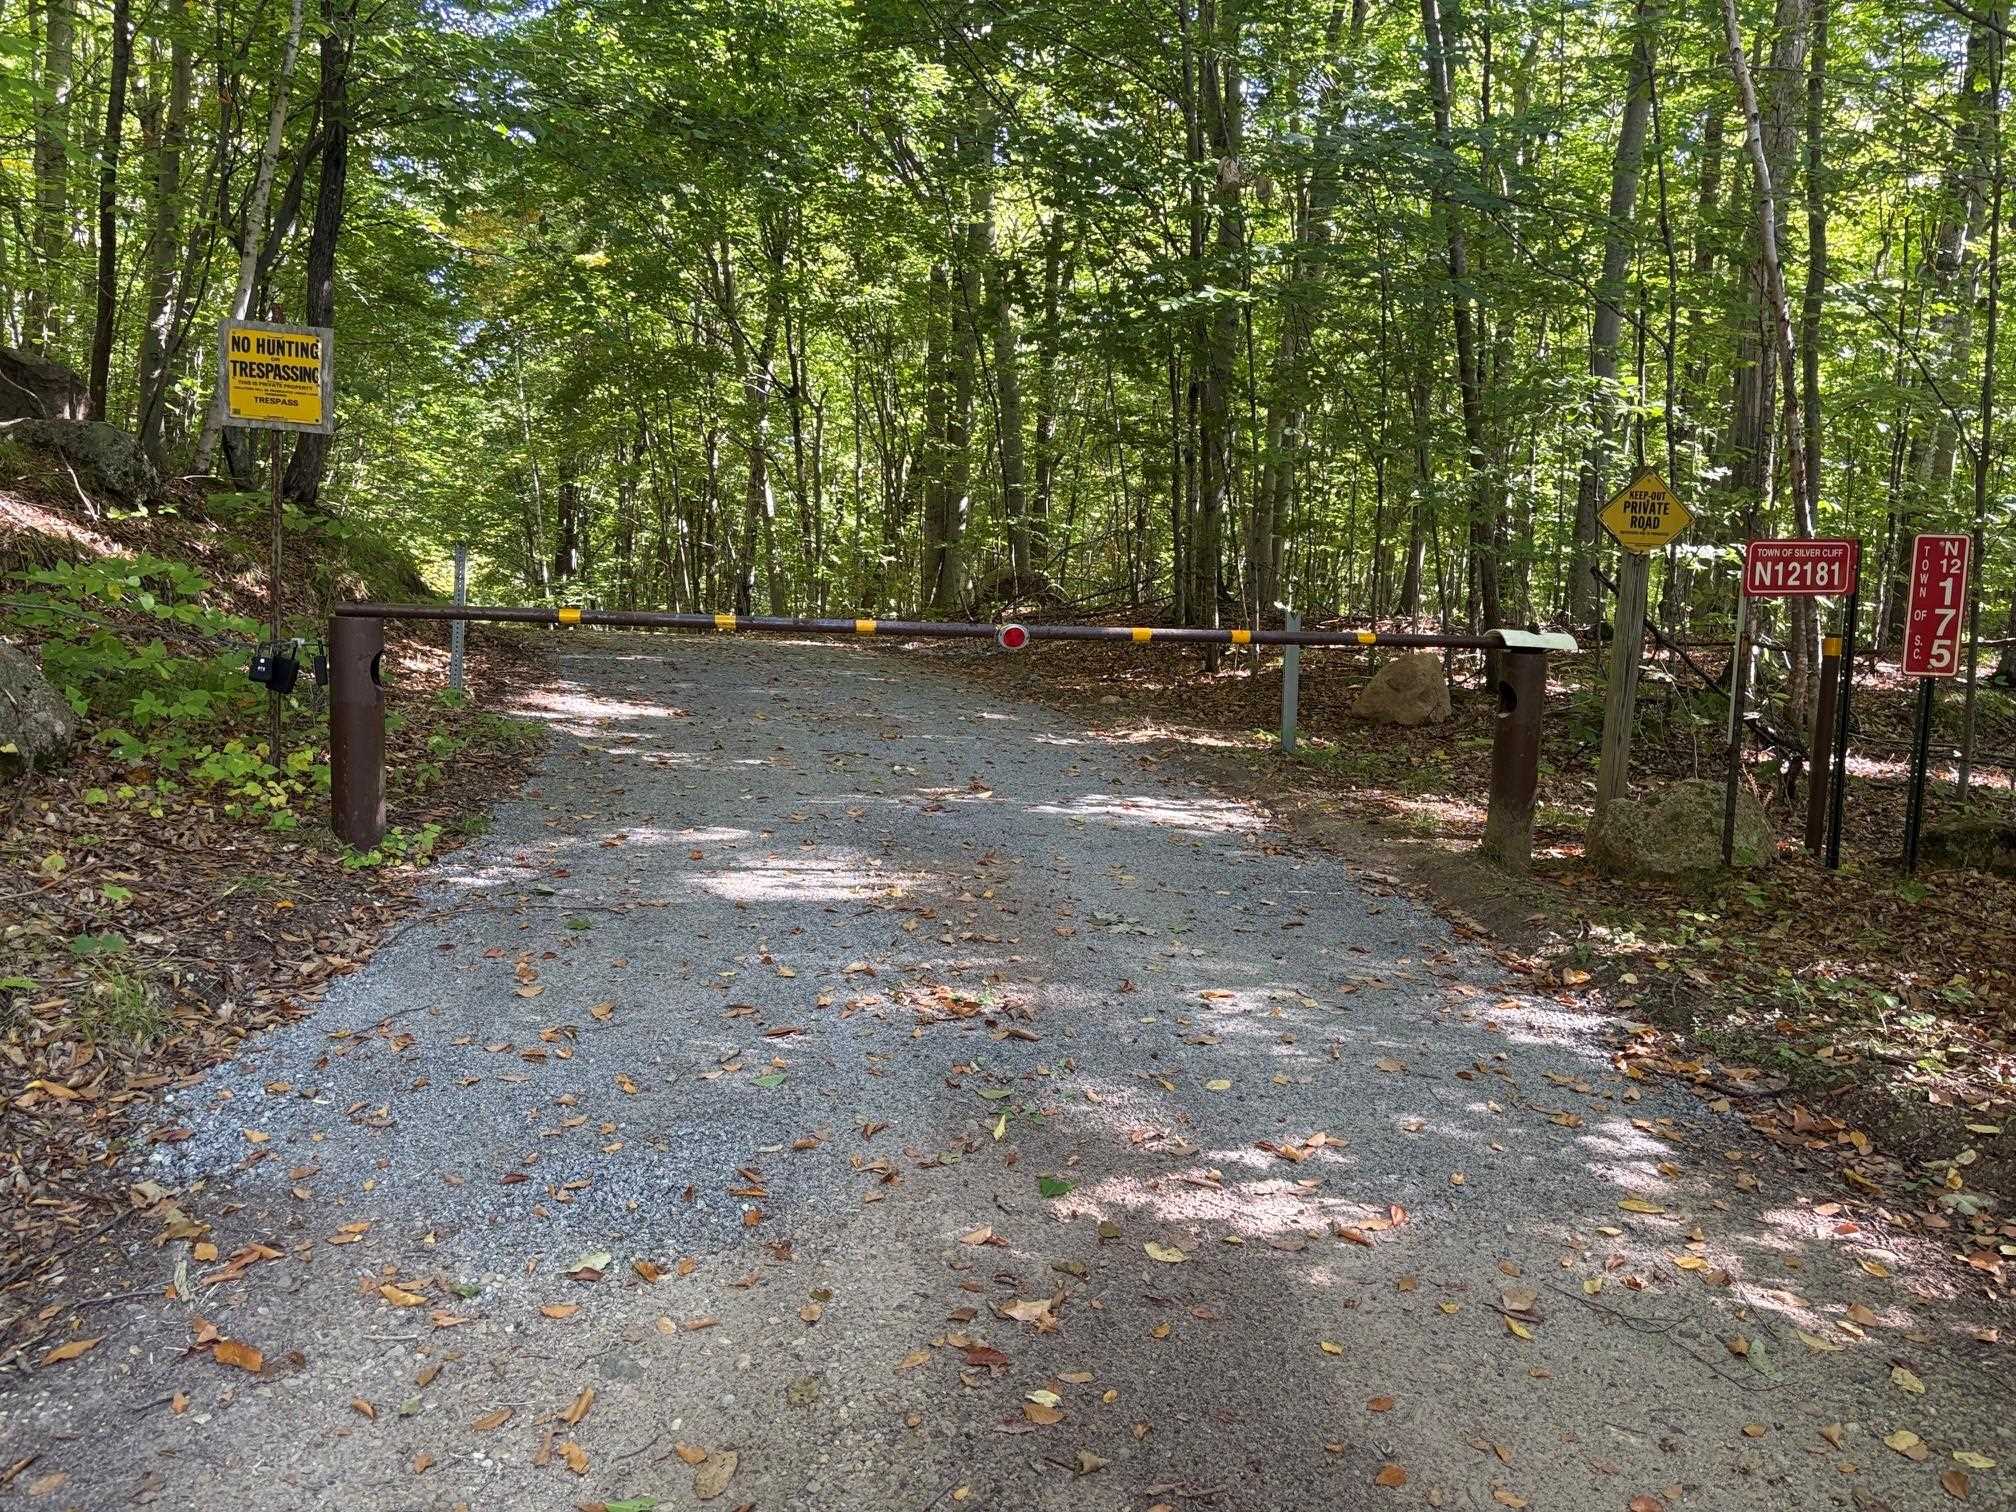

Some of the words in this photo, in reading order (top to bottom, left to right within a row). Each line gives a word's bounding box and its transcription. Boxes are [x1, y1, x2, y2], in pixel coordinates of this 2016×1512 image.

[231, 335, 251, 353] NO
[256, 337, 319, 360] HUNTING
[230, 360, 319, 384] TRESPASSING
[259, 381, 283, 389] PRIVATE
[255, 396, 299, 407] TRESPASS
[1629, 490, 1667, 501] KEEP-OUT
[1623, 501, 1671, 515] PRIVATE
[1630, 515, 1660, 529] ROAD
[1758, 548, 1780, 557] TOWN
[1782, 548, 1793, 557] OF
[1794, 548, 1821, 557] SILVER
[1822, 548, 1844, 557] CLIFF
[1755, 561, 1840, 586] N12181
[1914, 609, 1928, 622] OF
